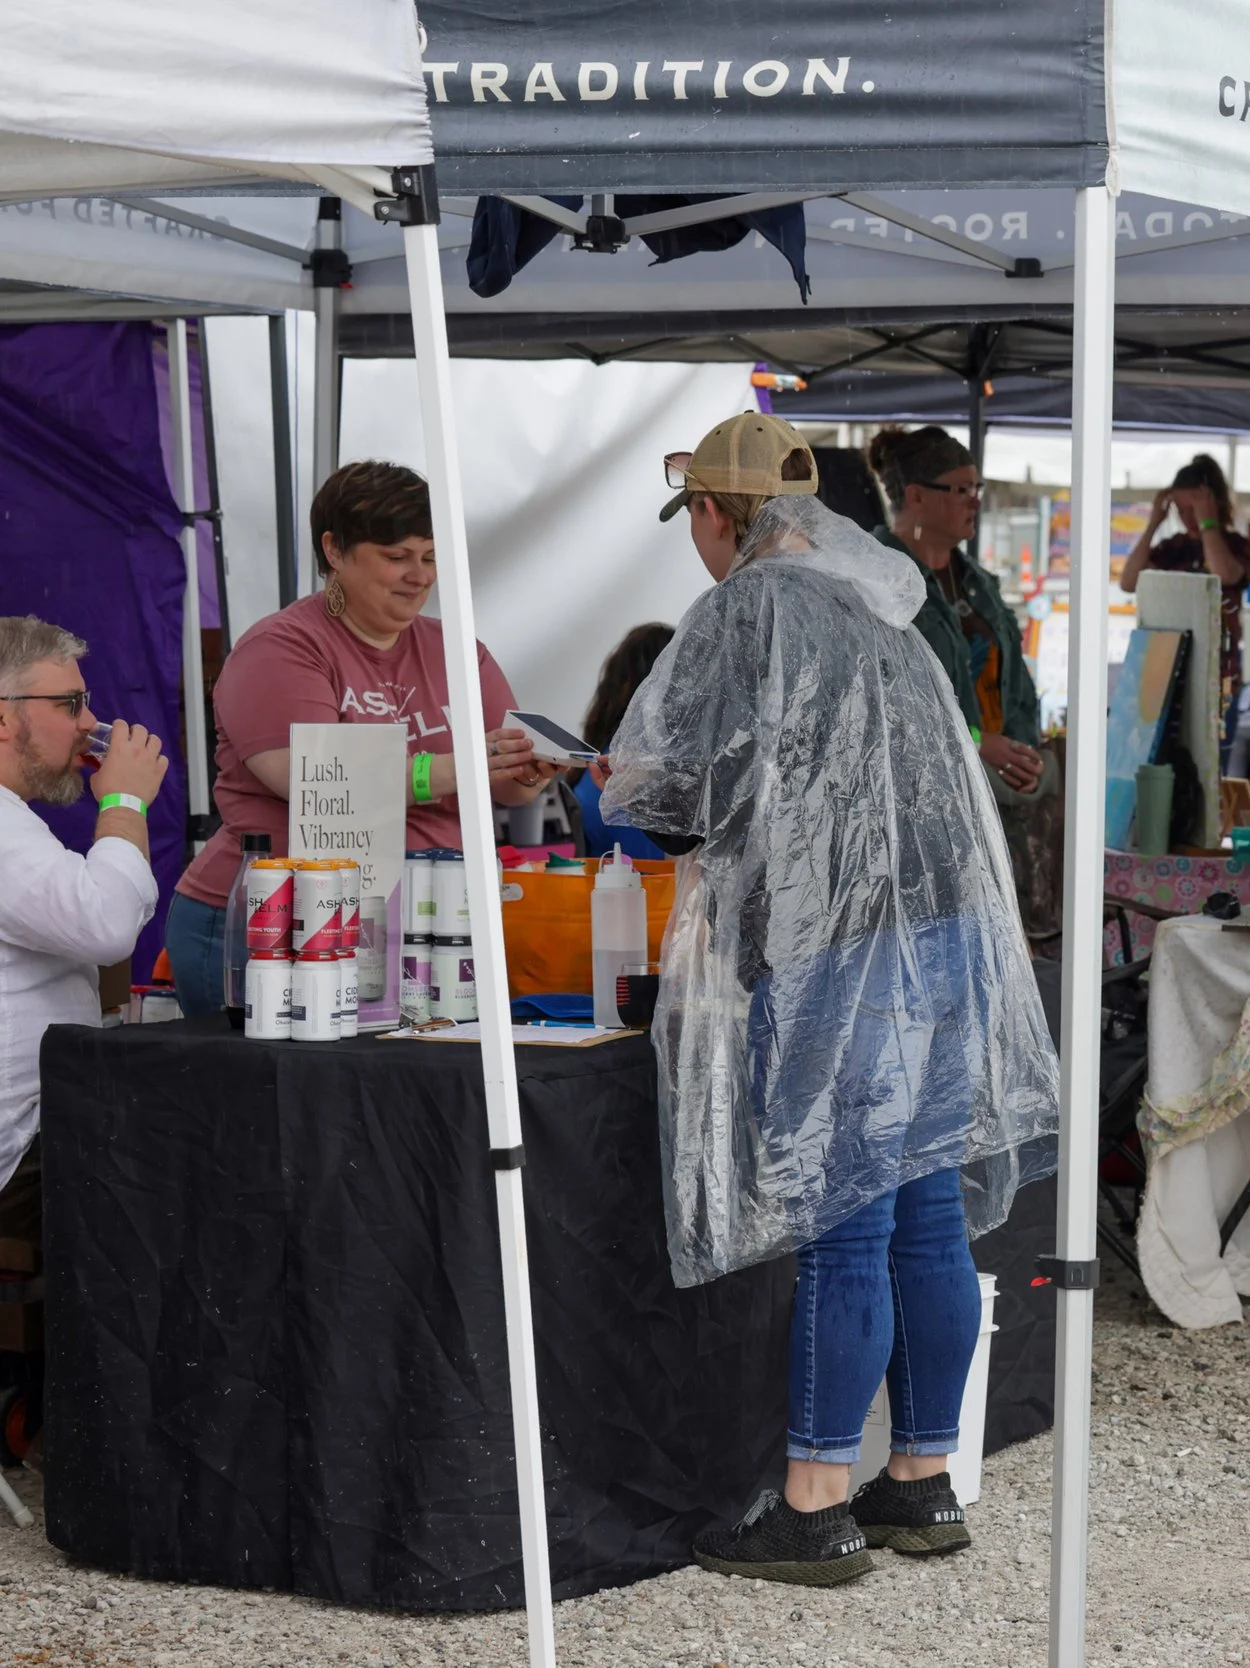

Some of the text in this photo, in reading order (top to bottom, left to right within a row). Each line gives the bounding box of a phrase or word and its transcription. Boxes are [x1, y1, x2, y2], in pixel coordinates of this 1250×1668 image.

[421, 56, 876, 103] TRADITION.
[340, 686, 398, 716] AS
[301, 755, 349, 783] Lush.
[300, 789, 355, 817] Floral.
[299, 823, 374, 857] Vibrancy
